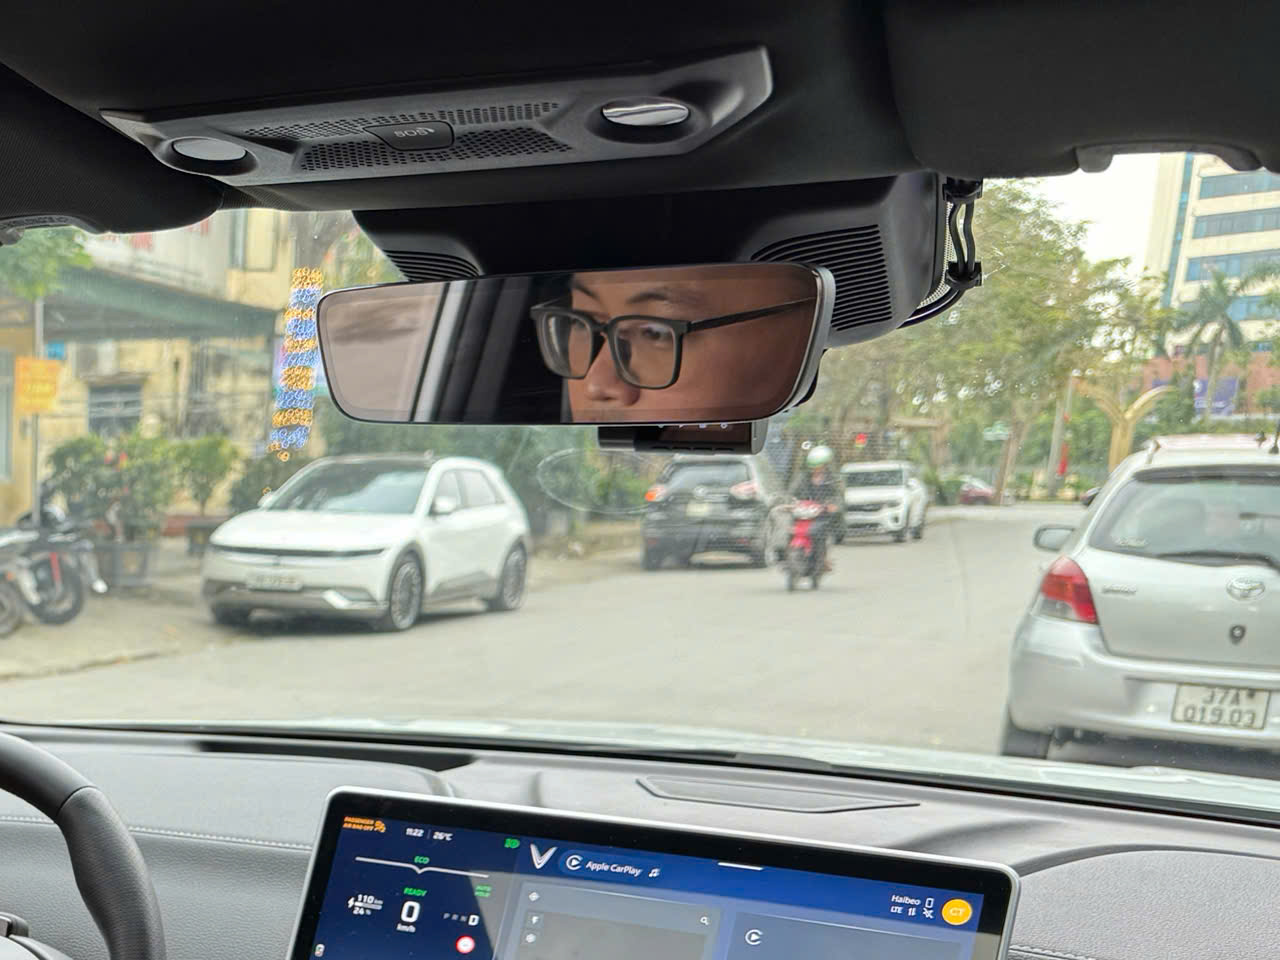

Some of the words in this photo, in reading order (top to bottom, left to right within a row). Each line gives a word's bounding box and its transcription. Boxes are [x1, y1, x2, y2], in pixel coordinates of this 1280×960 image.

[394, 127, 428, 138] SOS
[414, 855, 430, 864] ECO
[586, 860, 610, 872] Apple
[610, 864, 643, 878] CarPlay
[400, 900, 420, 923] 0
